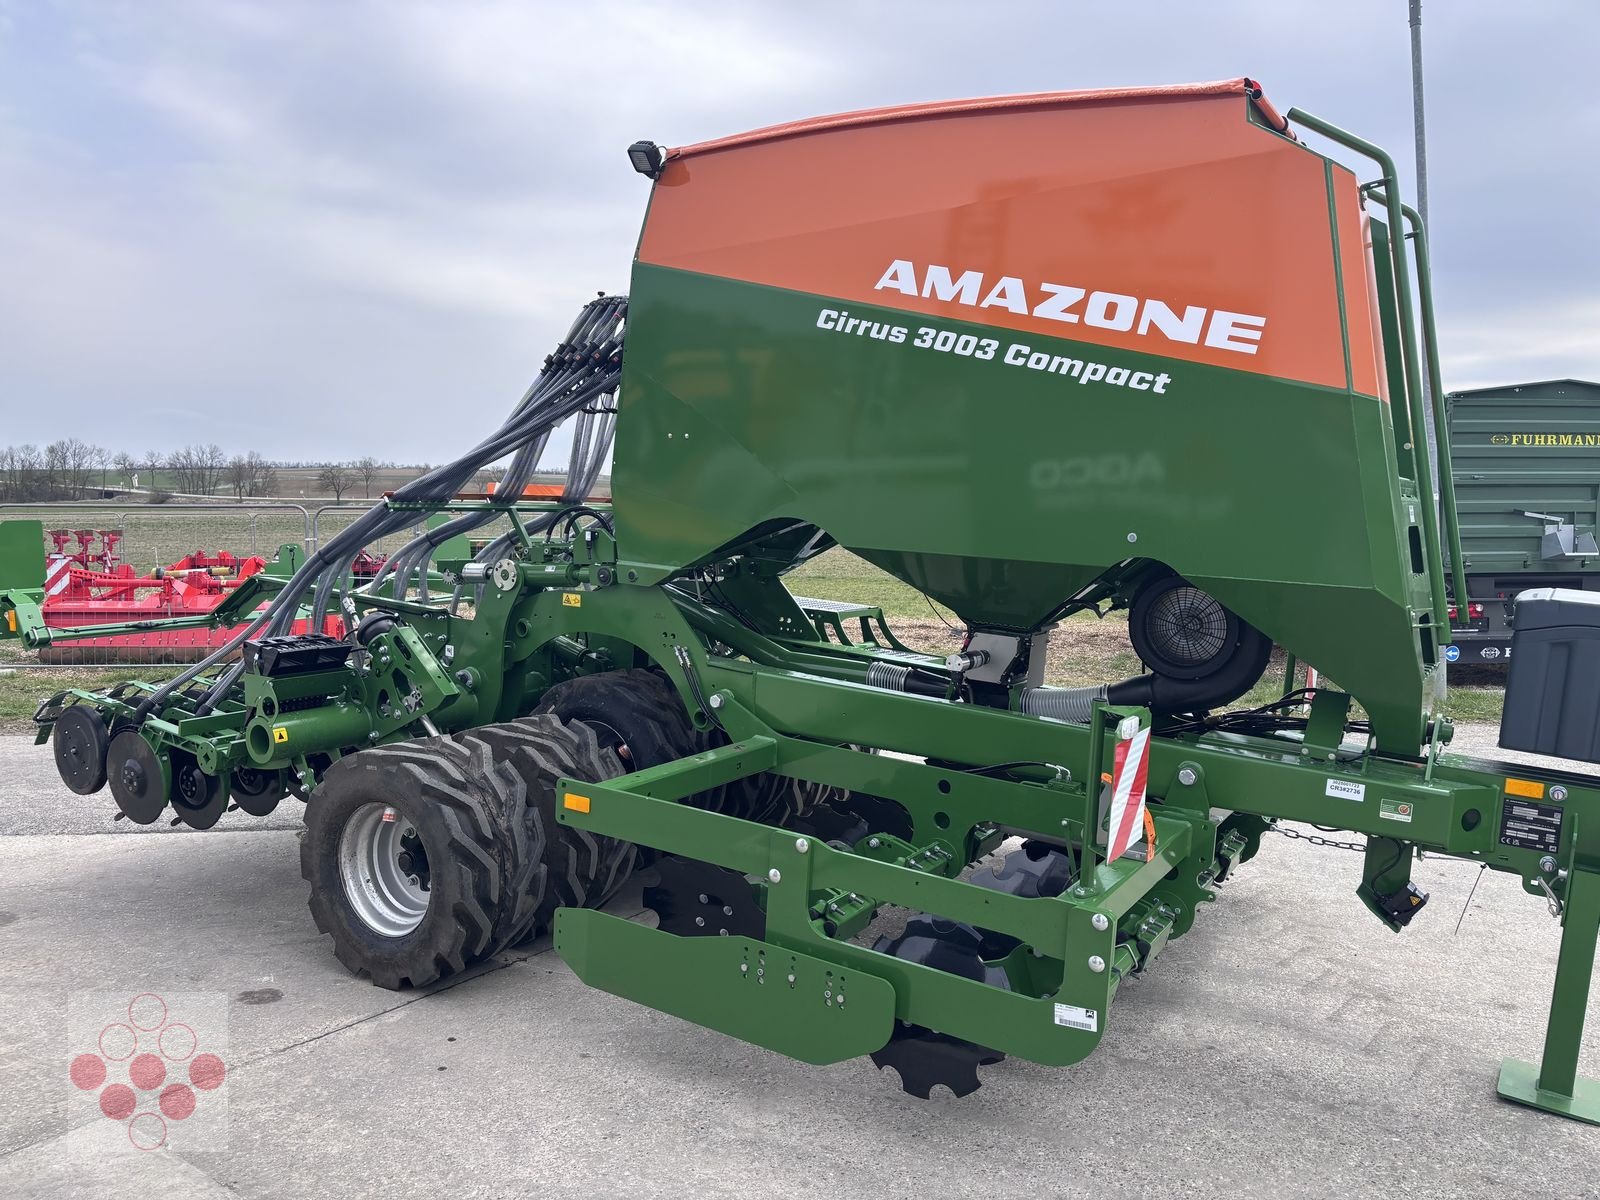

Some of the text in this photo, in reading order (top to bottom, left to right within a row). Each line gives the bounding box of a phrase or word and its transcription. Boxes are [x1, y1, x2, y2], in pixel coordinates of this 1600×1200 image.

[816, 308, 1172, 394] Cirrus 3003 Compact
[874, 259, 1267, 355] AMAZONE
